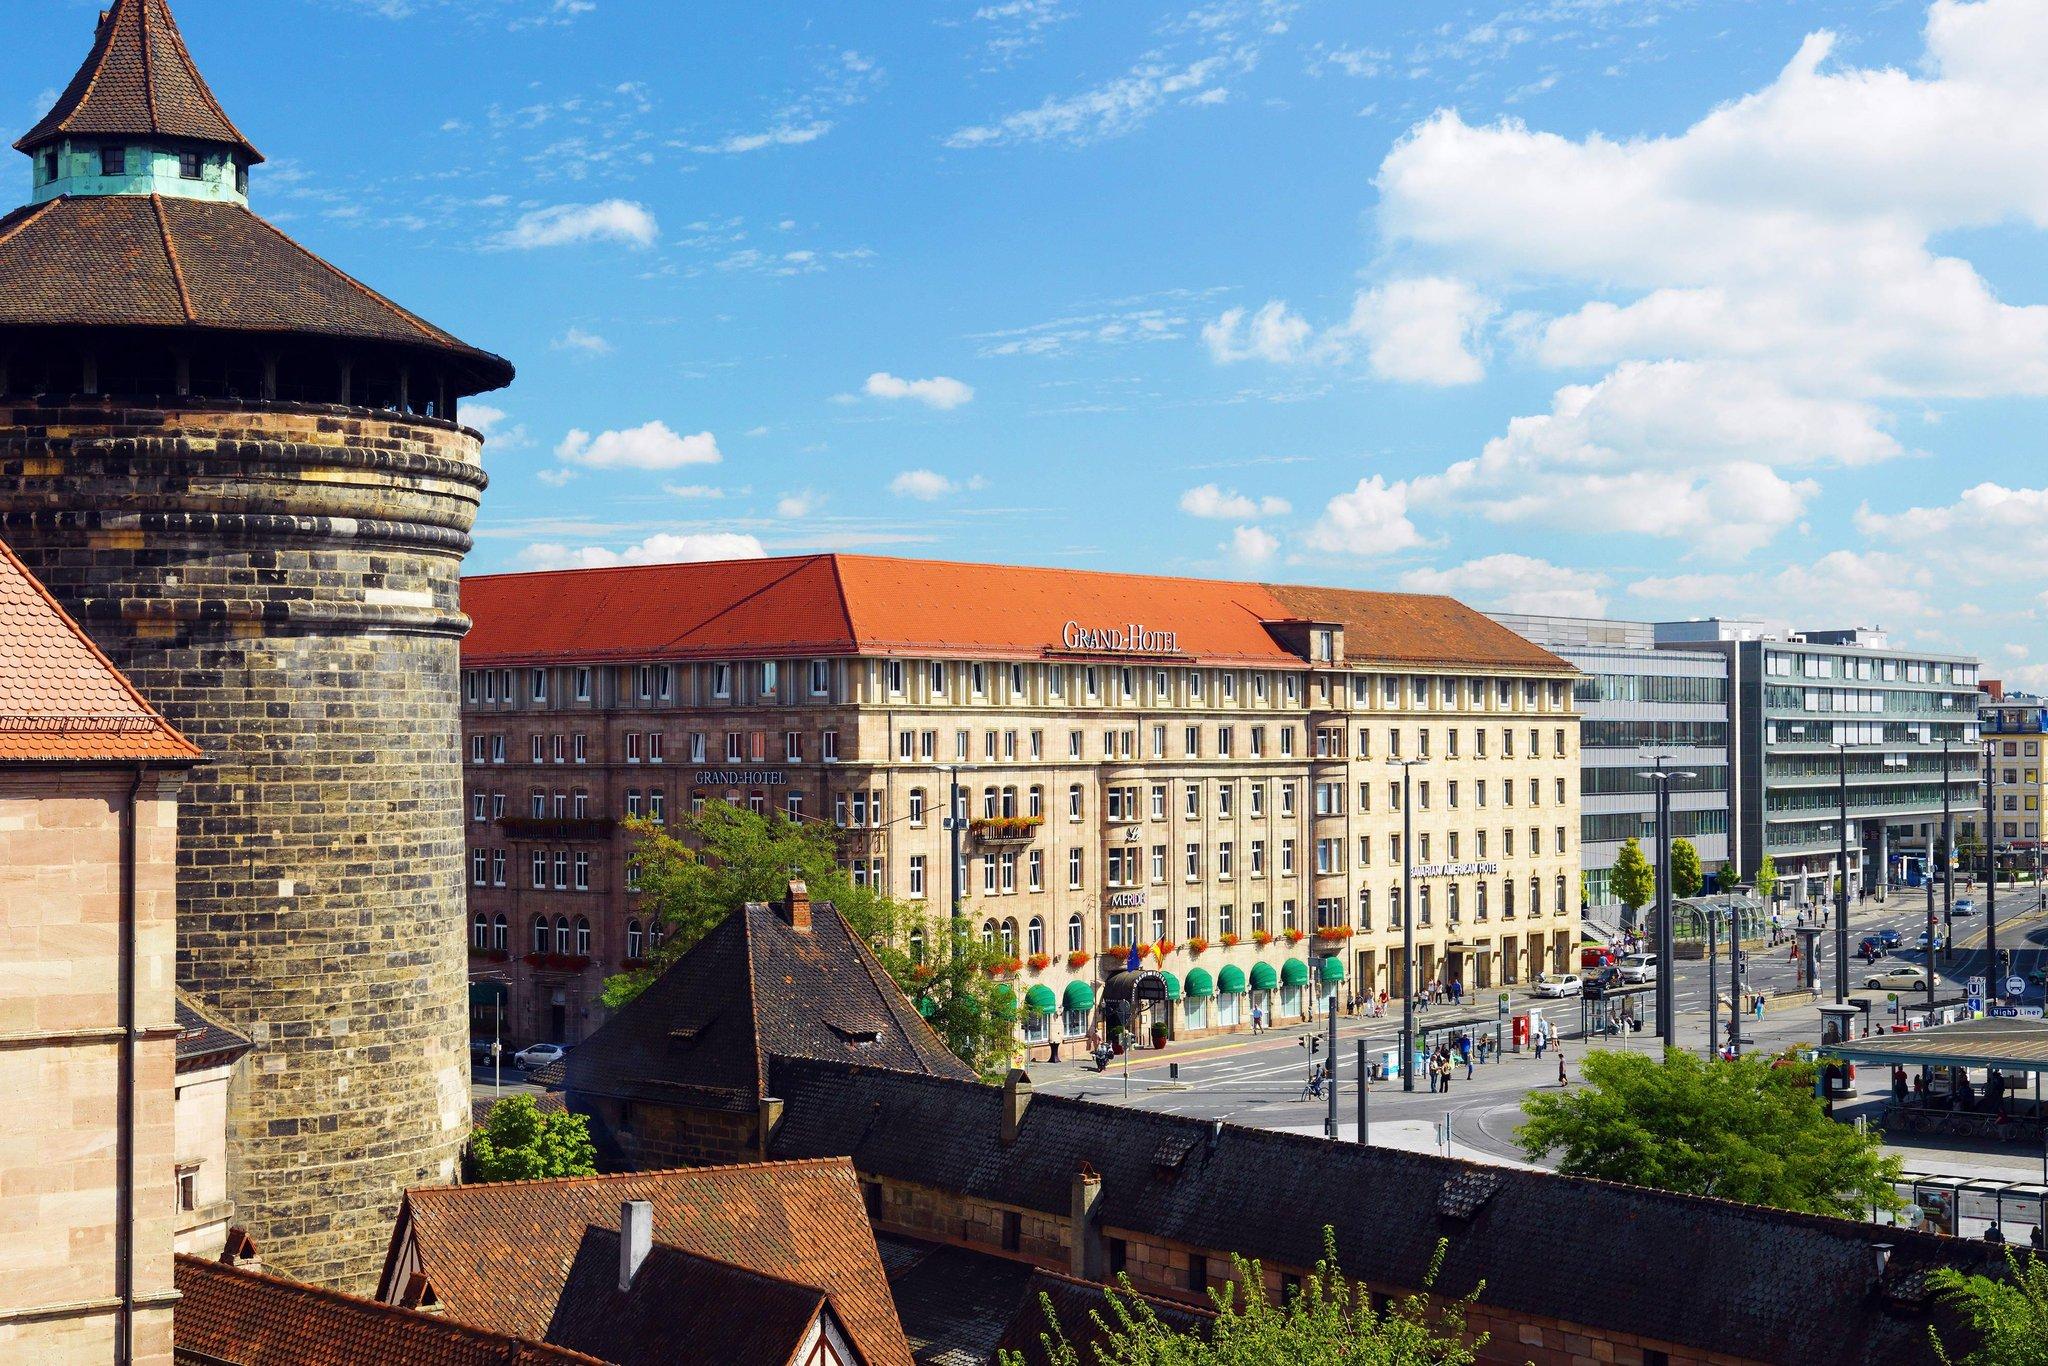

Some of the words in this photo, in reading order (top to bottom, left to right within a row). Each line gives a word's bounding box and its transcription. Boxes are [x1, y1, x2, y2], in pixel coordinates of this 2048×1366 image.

[1444, 863, 1478, 876] AMERICAN
[1969, 984, 1979, 995] U
[1993, 1008, 2016, 1017] Night
[2019, 1008, 2040, 1016] Liner
